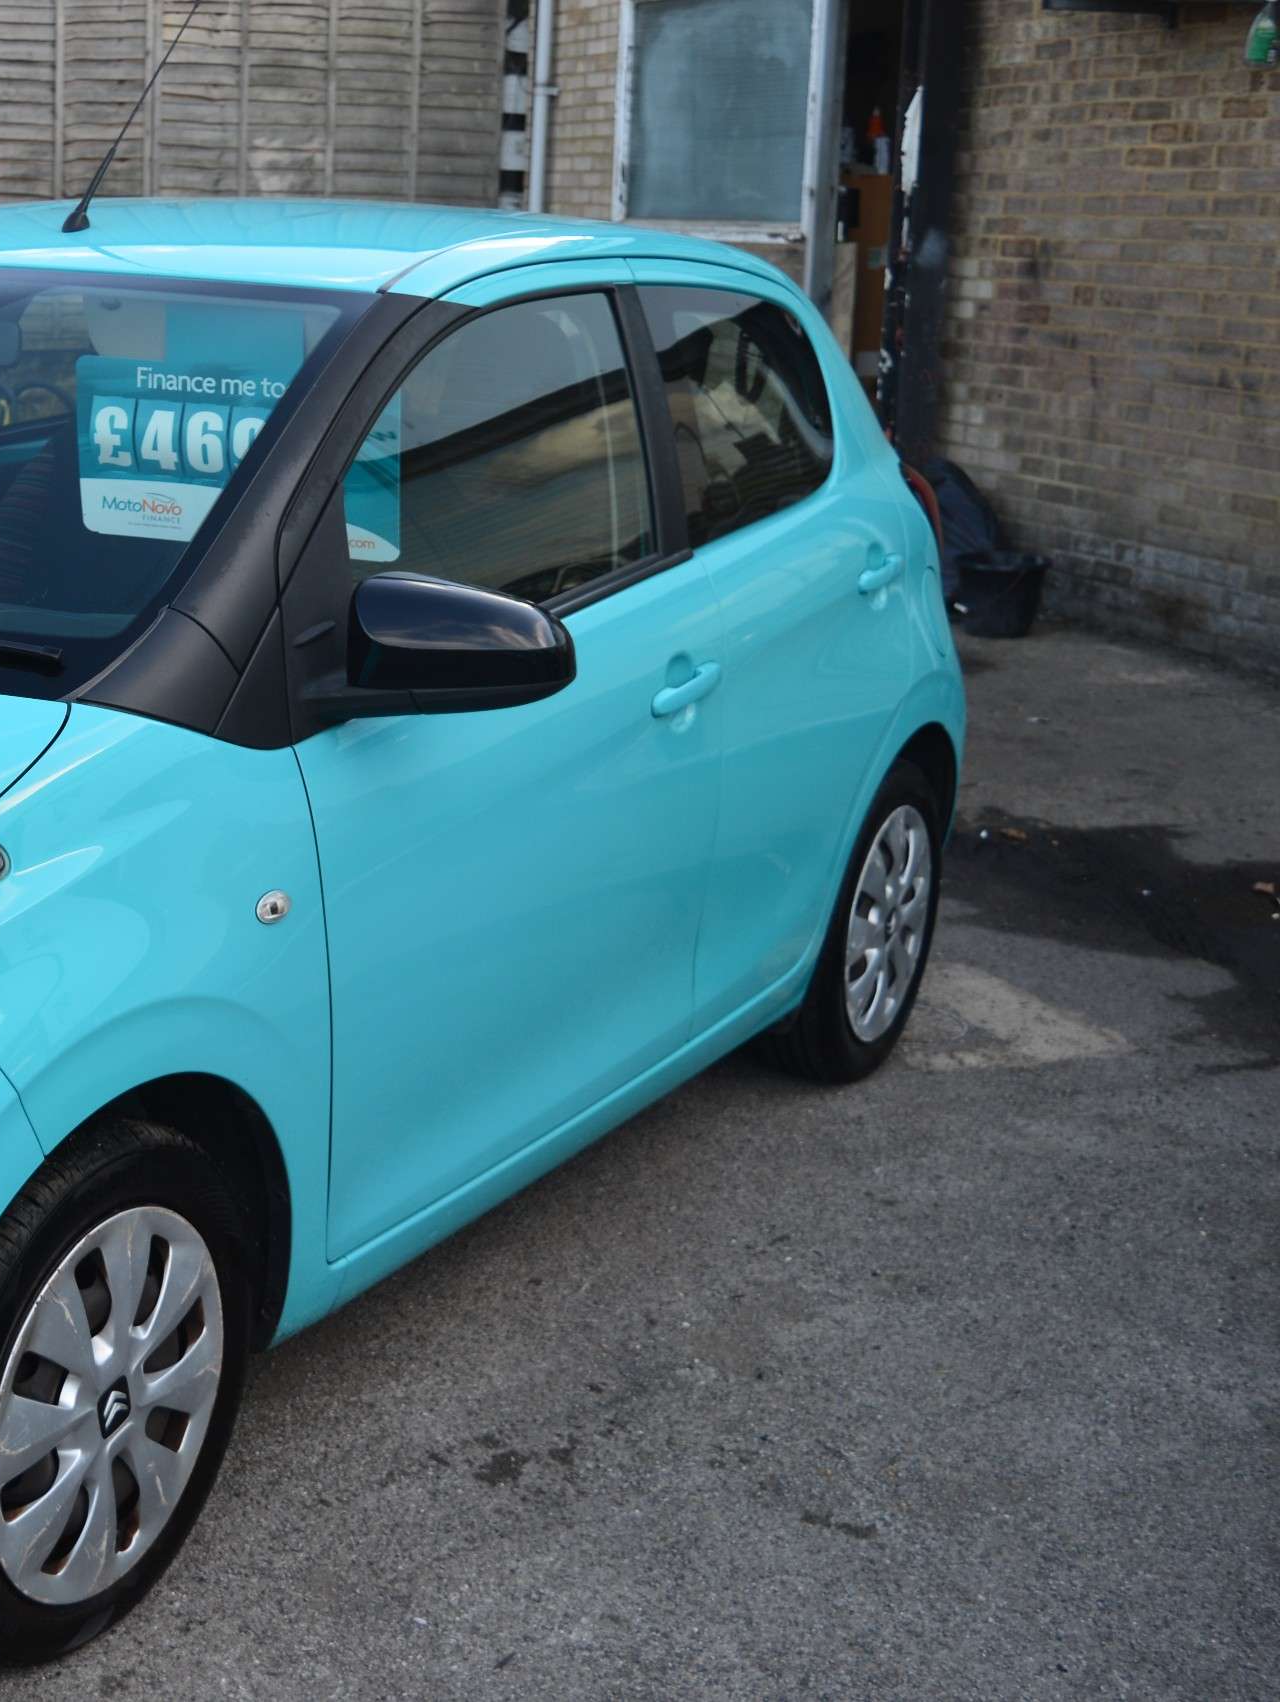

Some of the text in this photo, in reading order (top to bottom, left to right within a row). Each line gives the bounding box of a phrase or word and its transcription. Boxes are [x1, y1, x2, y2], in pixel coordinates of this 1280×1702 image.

[136, 366, 216, 394] Finance
[221, 377, 256, 397] me
[102, 495, 183, 516] MotoNovo
